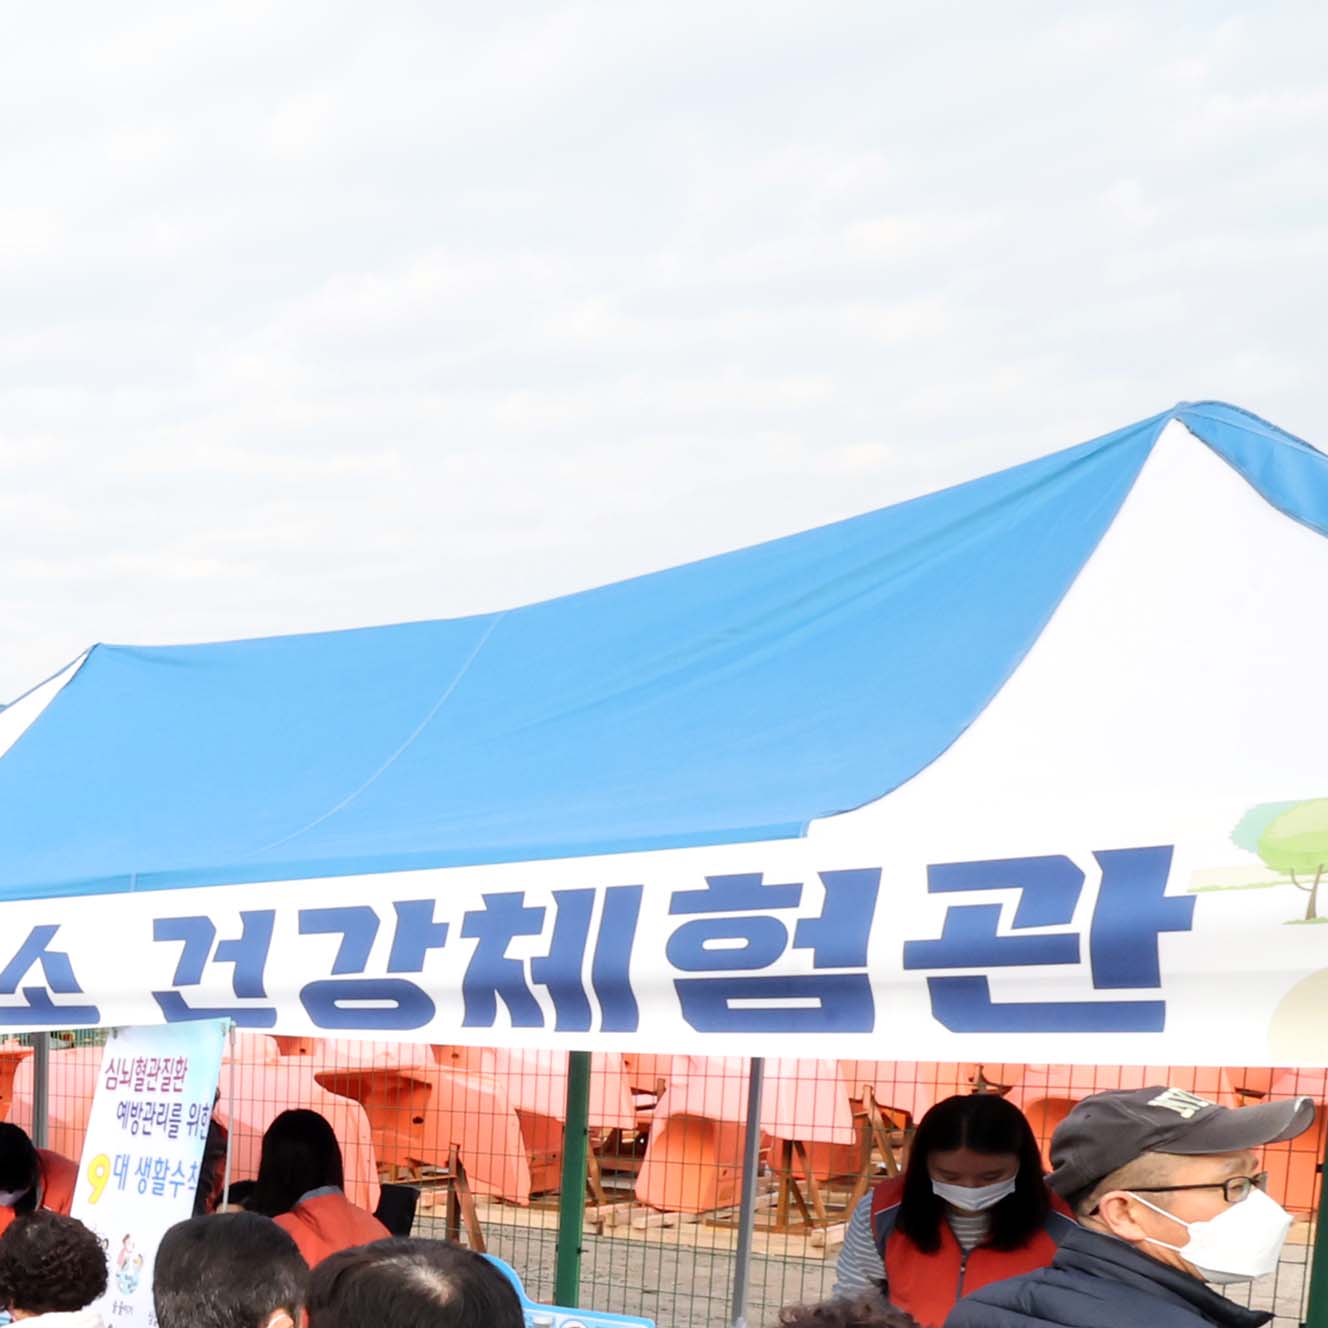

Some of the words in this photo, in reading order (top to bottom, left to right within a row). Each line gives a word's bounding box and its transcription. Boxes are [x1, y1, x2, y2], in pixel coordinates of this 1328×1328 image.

[149, 843, 1196, 1034] 건강체험관
[105, 1056, 188, 1093] 심뇌혈관질환
[116, 1099, 183, 1139] 예방관리를
